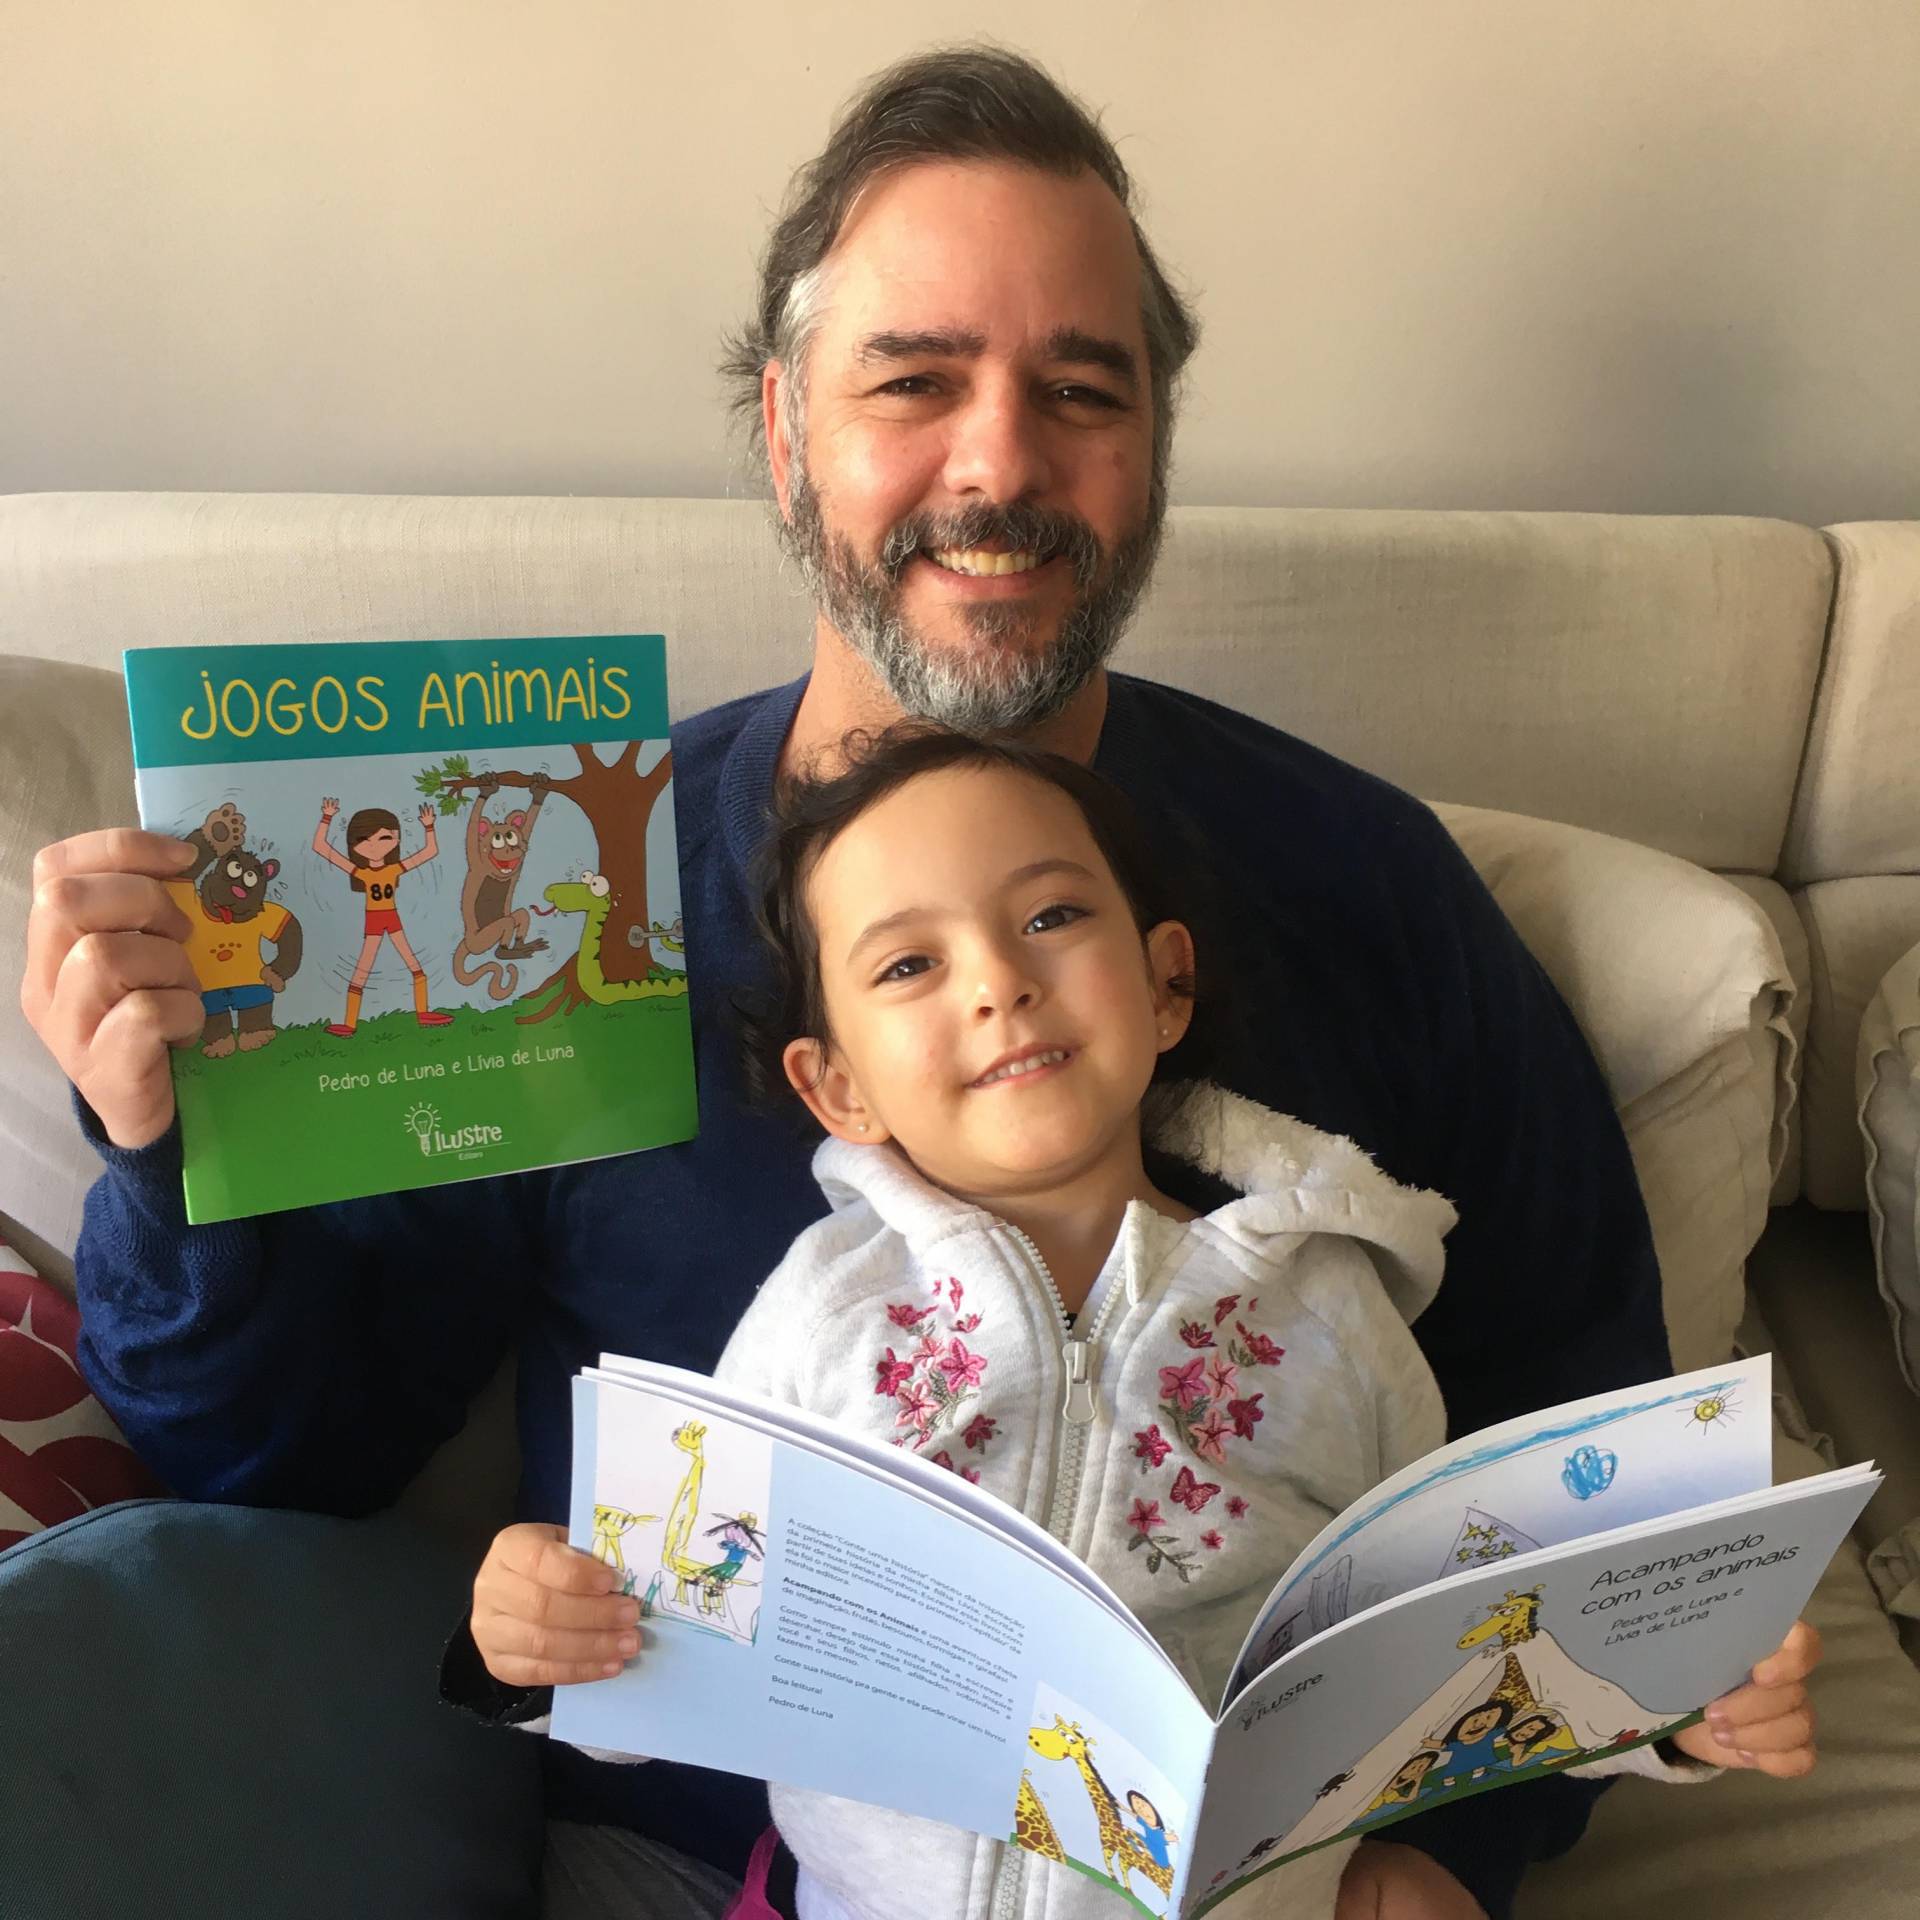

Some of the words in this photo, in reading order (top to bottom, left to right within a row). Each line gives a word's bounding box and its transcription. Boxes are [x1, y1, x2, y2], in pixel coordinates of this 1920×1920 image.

[370, 883, 394, 901] 80
[319, 1074, 370, 1092] Pedro
[377, 1068, 397, 1084] de
[403, 1063, 445, 1081] Luna
[452, 1061, 462, 1074] e
[468, 1055, 505, 1072] Lívia
[511, 1050, 530, 1066] de
[536, 1045, 574, 1062] Luna
[785, 1558, 814, 1572] minha
[785, 1548, 799, 1557] ela
[801, 1553, 813, 1562] foi
[823, 1562, 850, 1575] maior
[852, 1573, 894, 1593] incentivo
[895, 1591, 916, 1603] para
[786, 1539, 811, 1550] partir
[828, 1553, 848, 1564] suas
[849, 1562, 875, 1576] ideias
[787, 1528, 799, 1536] da
[803, 1535, 842, 1552] primeira
[846, 1550, 880, 1568] história
[885, 1567, 896, 1575] da
[900, 1574, 930, 1590] minha
[934, 1588, 953, 1601] filha
[797, 1522, 833, 1539] coleção
[868, 1551, 888, 1562] uma
[930, 1578, 962, 1596] nasceu
[964, 1594, 976, 1603] da
[1589, 1533, 1764, 1591] Acampando
[1581, 1588, 1641, 1615] com
[1653, 1576, 1686, 1595] os
[1696, 1546, 1800, 1584] animais
[782, 1587, 793, 1595] de
[927, 1641, 966, 1662] formigas
[784, 1577, 841, 1601] Acampando
[844, 1599, 864, 1610] com
[880, 1612, 919, 1632] Animais
[929, 1634, 949, 1646] uma
[952, 1644, 991, 1665] aventura
[993, 1664, 1017, 1679] cheia
[1610, 1612, 1658, 1630] Pedro
[1664, 1604, 1683, 1616] de
[1689, 1591, 1727, 1608] Luna
[1734, 1588, 1744, 1597] e
[1647, 1622, 1664, 1634] de
[1671, 1610, 1710, 1628] Luna
[777, 1635, 813, 1651] fazerem
[824, 1651, 859, 1666] mesmo.
[778, 1625, 799, 1636] você
[817, 1638, 838, 1649] seus
[780, 1605, 808, 1619] Como
[813, 1617, 847, 1633] sempre
[896, 1648, 925, 1663] minha
[931, 1661, 950, 1673] filha
[966, 1678, 1003, 1697] escrever
[826, 1632, 856, 1646] desejo
[859, 1643, 877, 1654] que
[880, 1651, 899, 1662] essa
[903, 1660, 937, 1676] história
[772, 1675, 789, 1685] Boa
[791, 1680, 822, 1694] leitura!
[774, 1655, 801, 1667] Conte
[803, 1664, 819, 1672] sua
[820, 1669, 853, 1683] história
[855, 1681, 870, 1690] pra
[872, 1686, 897, 1699] gente
[907, 1699, 920, 1707] ela
[922, 1705, 945, 1717] pode
[947, 1714, 966, 1725] virar
[968, 1723, 983, 1733] um
[769, 1696, 795, 1708] Pedro
[797, 1703, 809, 1712] de
[812, 1707, 834, 1719] Luna
